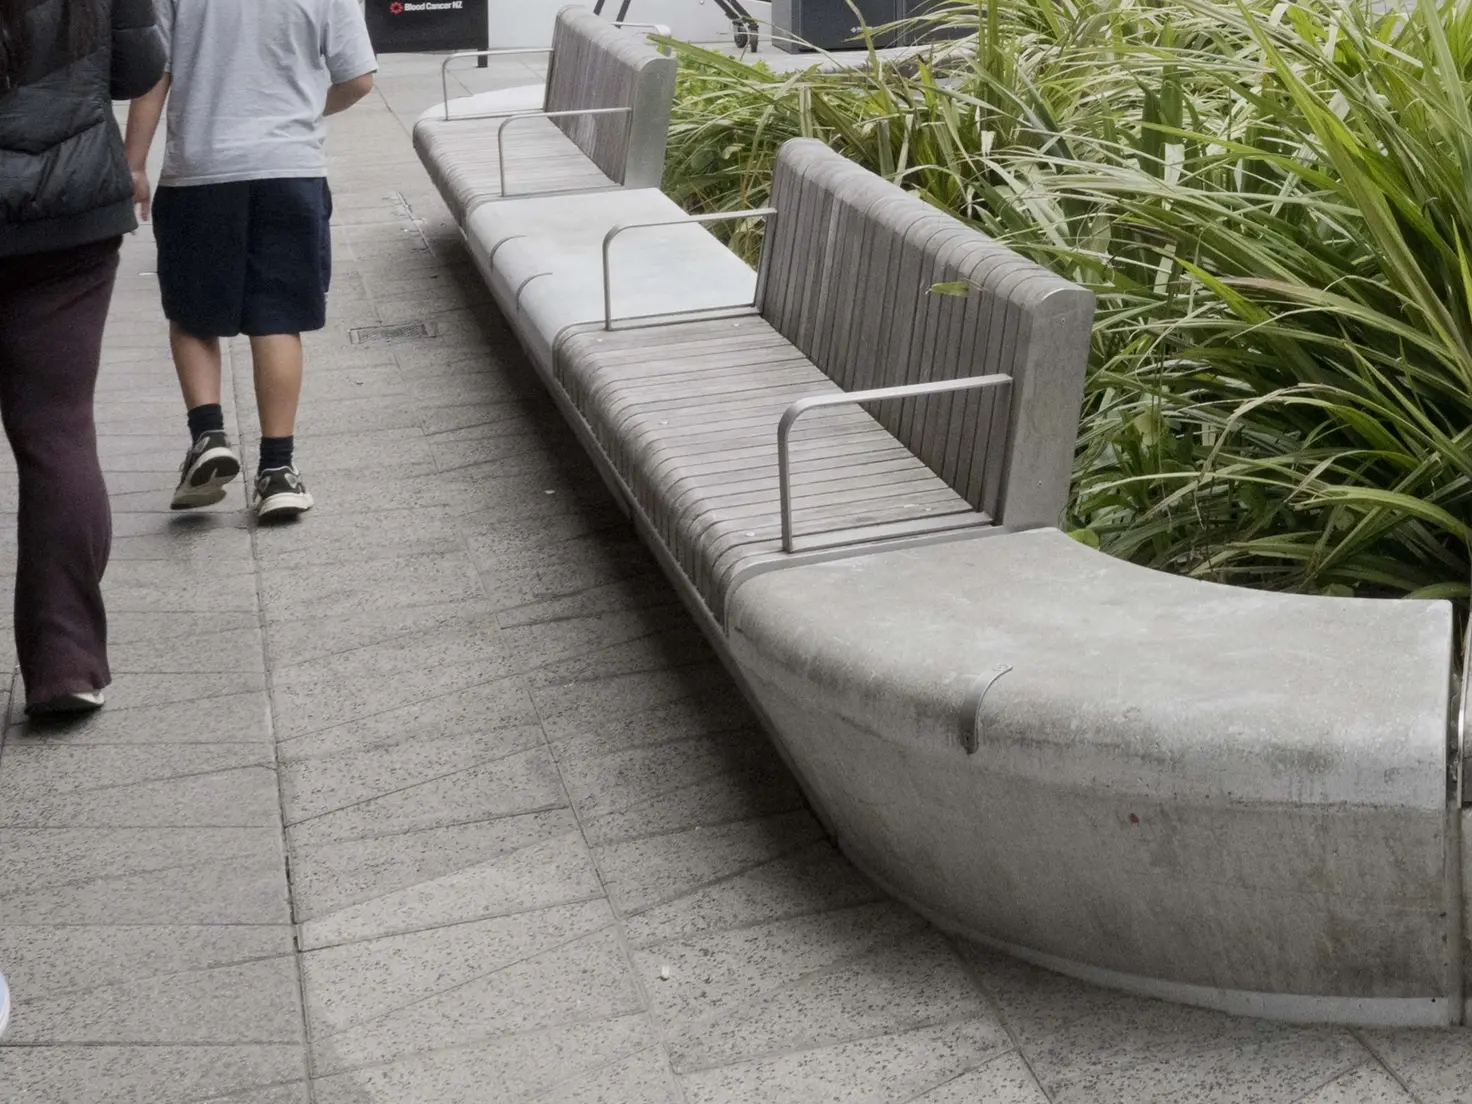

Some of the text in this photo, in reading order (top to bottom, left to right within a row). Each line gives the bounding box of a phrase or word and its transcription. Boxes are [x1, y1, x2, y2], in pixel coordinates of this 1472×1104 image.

[404, 0, 464, 11] Blood Cancer NZ
